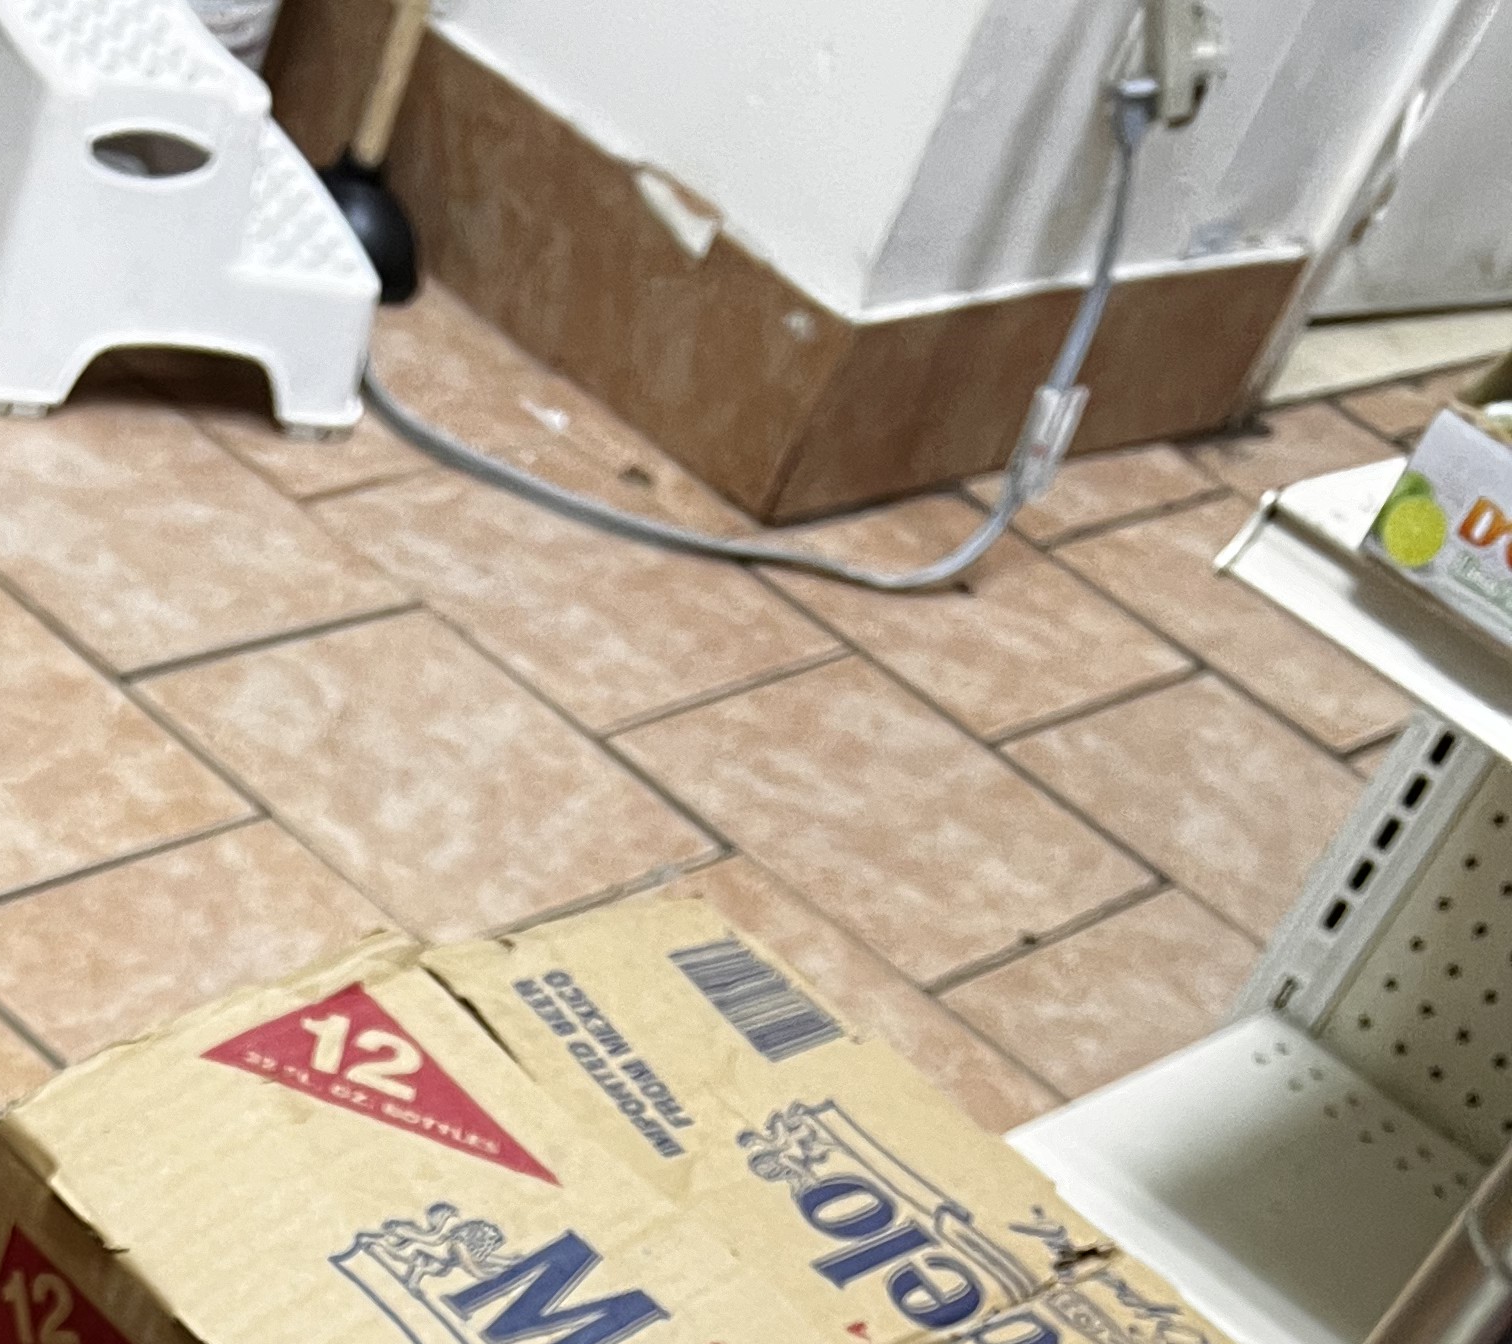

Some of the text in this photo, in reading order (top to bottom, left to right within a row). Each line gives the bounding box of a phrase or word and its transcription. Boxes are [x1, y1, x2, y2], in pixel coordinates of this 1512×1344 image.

[299, 1013, 425, 1102] 12
[513, 977, 686, 1159] IMPORTED BEER
[543, 970, 696, 1129] FROM MEXICO
[380, 1102, 502, 1155] BOTTLES
